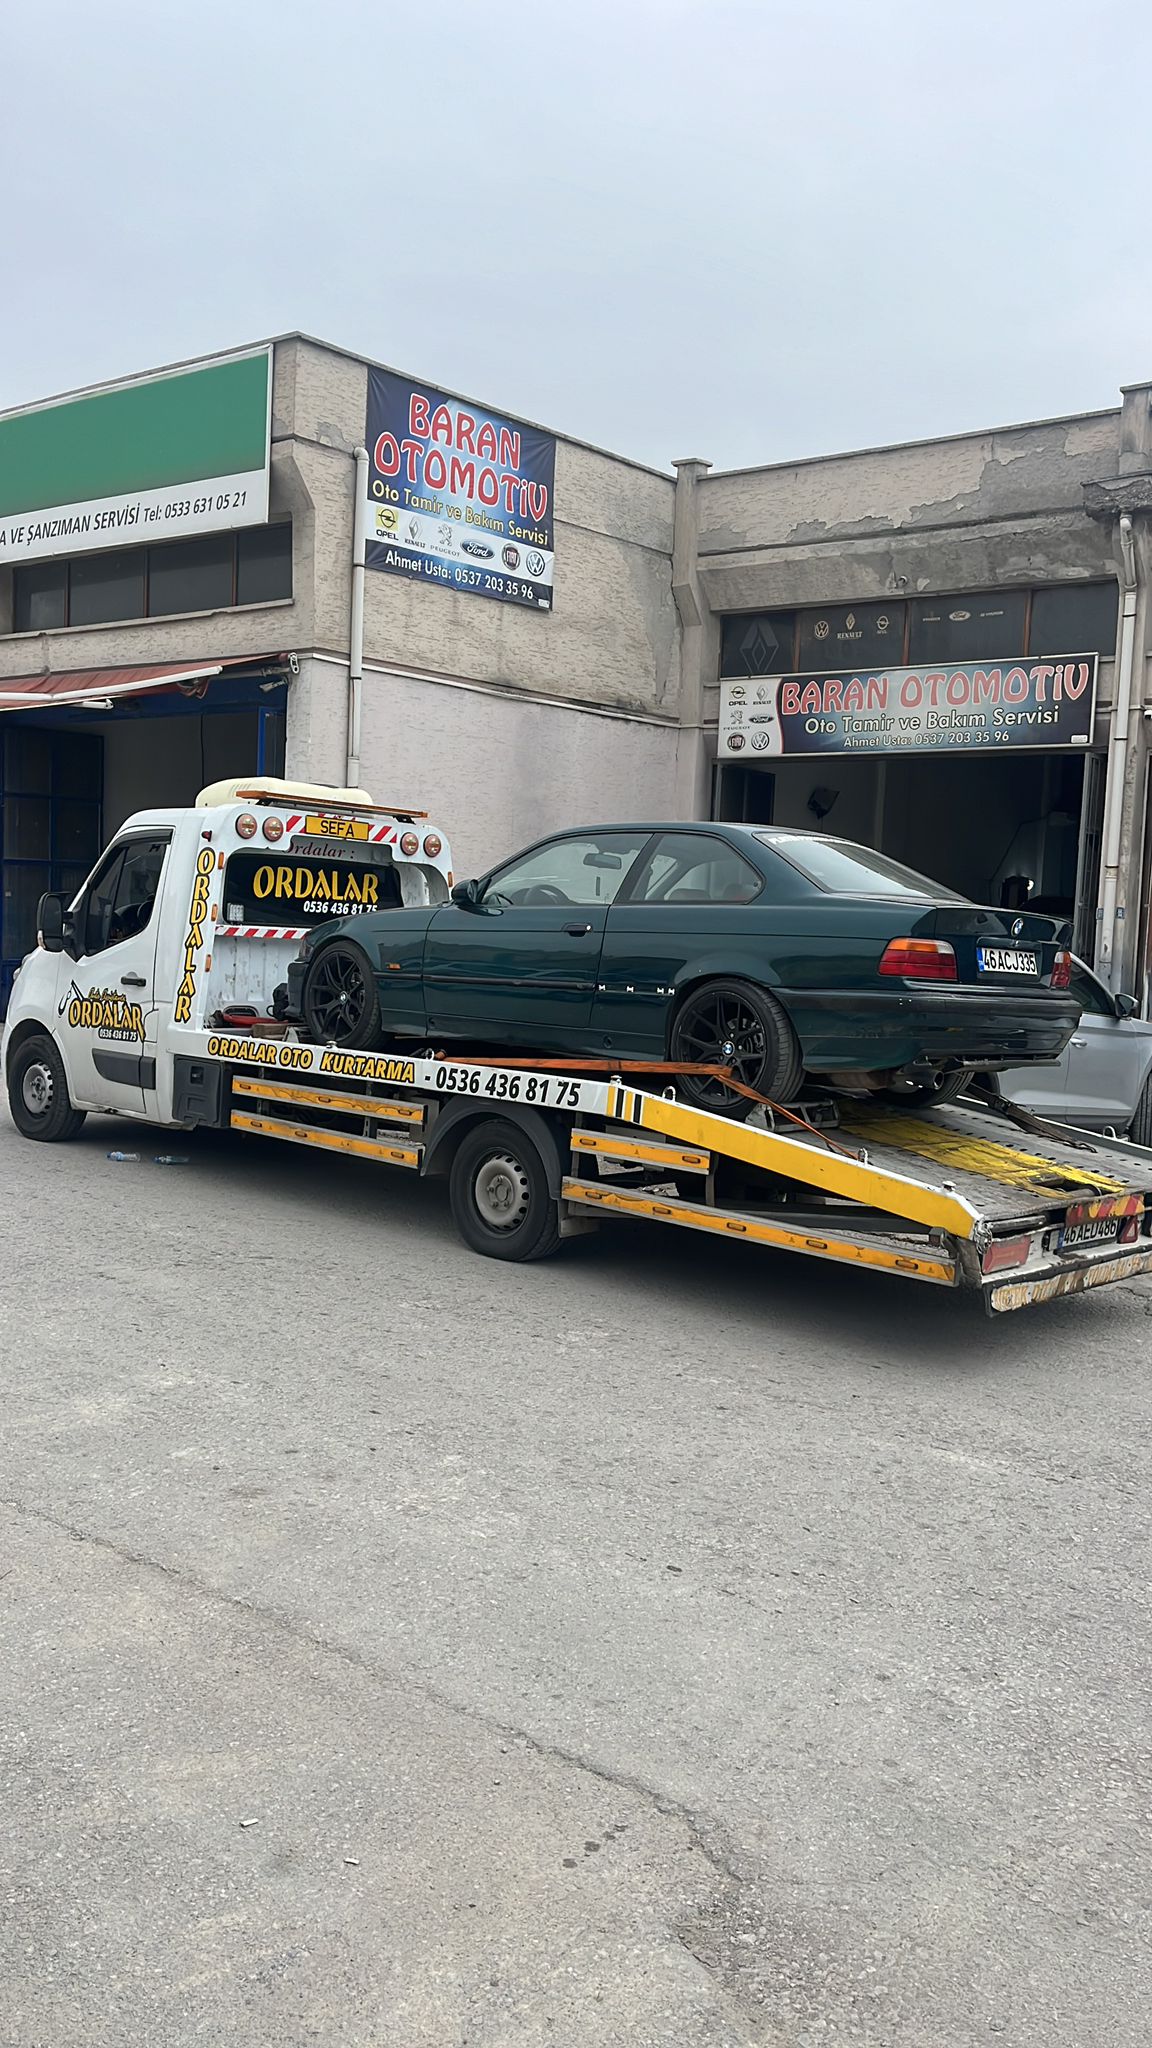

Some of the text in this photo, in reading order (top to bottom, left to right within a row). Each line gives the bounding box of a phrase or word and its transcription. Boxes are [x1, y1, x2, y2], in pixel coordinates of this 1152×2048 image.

[409, 392, 521, 471] BARAN
[11, 526, 25, 545] VE
[27, 514, 91, 546] ŞANZIMAN
[94, 502, 139, 530] SERVİSİ
[144, 508, 161, 523] Tel:
[164, 500, 190, 520] 0533
[193, 496, 213, 513] 631
[216, 493, 230, 510] 05
[232, 491, 248, 507] 21
[372, 479, 548, 546] Oto Tamir ve Bakım Servisi
[376, 529, 399, 541] OPEL
[430, 544, 461, 557] PEUGEOT
[466, 541, 489, 558] Ford
[385, 550, 534, 600] Ahmet Usta: 0537 203 35 96
[781, 677, 889, 716] BARAN
[805, 705, 1060, 735] Oto Tamir ve Bakım Servisi
[843, 730, 1010, 748] Ahmet Usta: 0537 203 35 96
[320, 820, 355, 837] SEFA
[253, 866, 379, 904] ORDALAR
[303, 900, 329, 914] 0536
[330, 902, 350, 915] 436
[351, 904, 363, 915] 81
[175, 847, 216, 1024] ORDALAR
[69, 998, 146, 1042] ORDALAR
[100, 1028, 112, 1038] 0536
[130, 1032, 137, 1040] 75
[208, 1037, 276, 1064] ORDALAR
[279, 1047, 313, 1069] OTO
[319, 1051, 415, 1083] KURTARMA
[436, 1067, 481, 1093] 0536
[485, 1073, 521, 1099] 436
[526, 1077, 549, 1102] 81
[556, 1081, 581, 1107] 75
